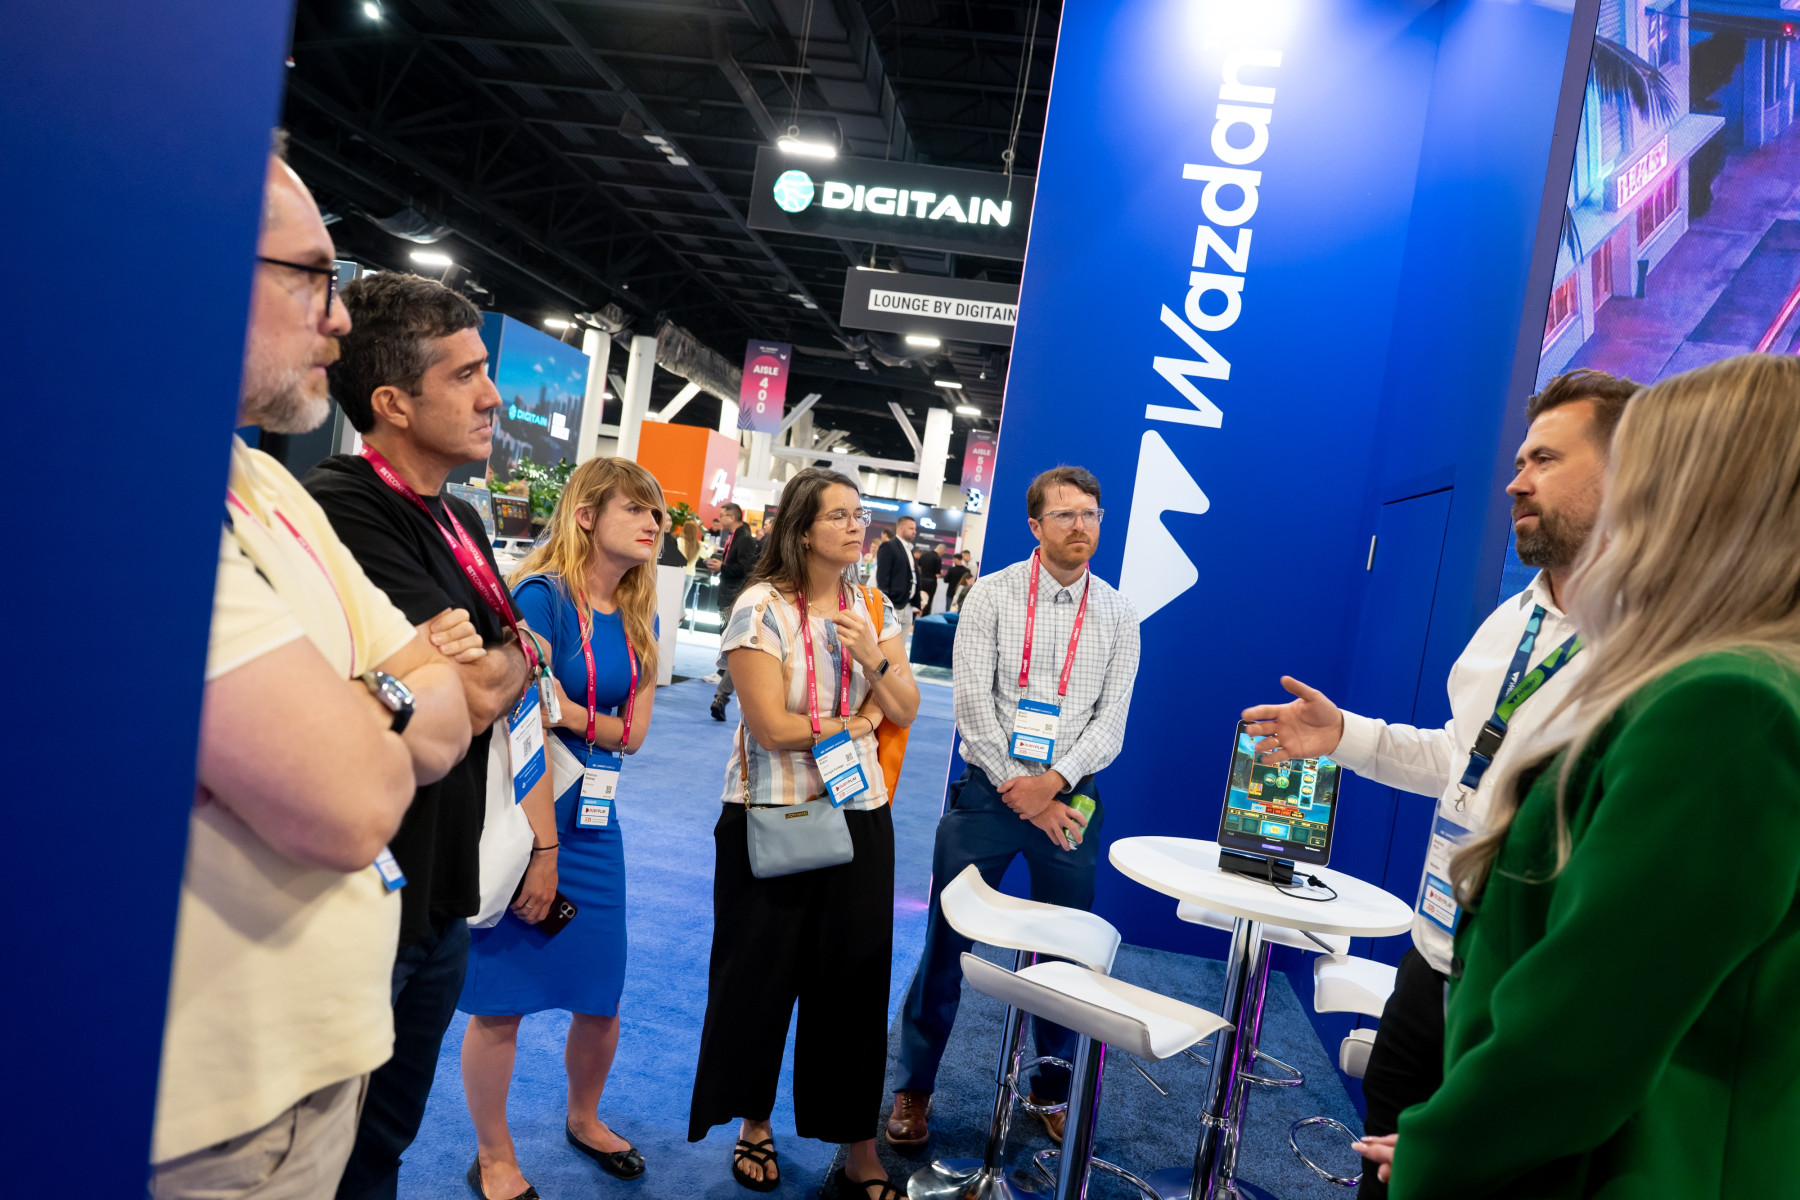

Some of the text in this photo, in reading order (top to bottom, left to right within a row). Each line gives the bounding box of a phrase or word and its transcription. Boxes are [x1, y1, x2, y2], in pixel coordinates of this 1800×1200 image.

[821, 181, 1013, 227] DIGITAIN
[1145, 48, 1283, 429] Wazdan
[874, 293, 1017, 322] LOUNGE BY DIGITAIN
[753, 364, 779, 376] AISLE
[517, 409, 548, 427] DIGITAIN
[972, 447, 991, 456] AISLE
